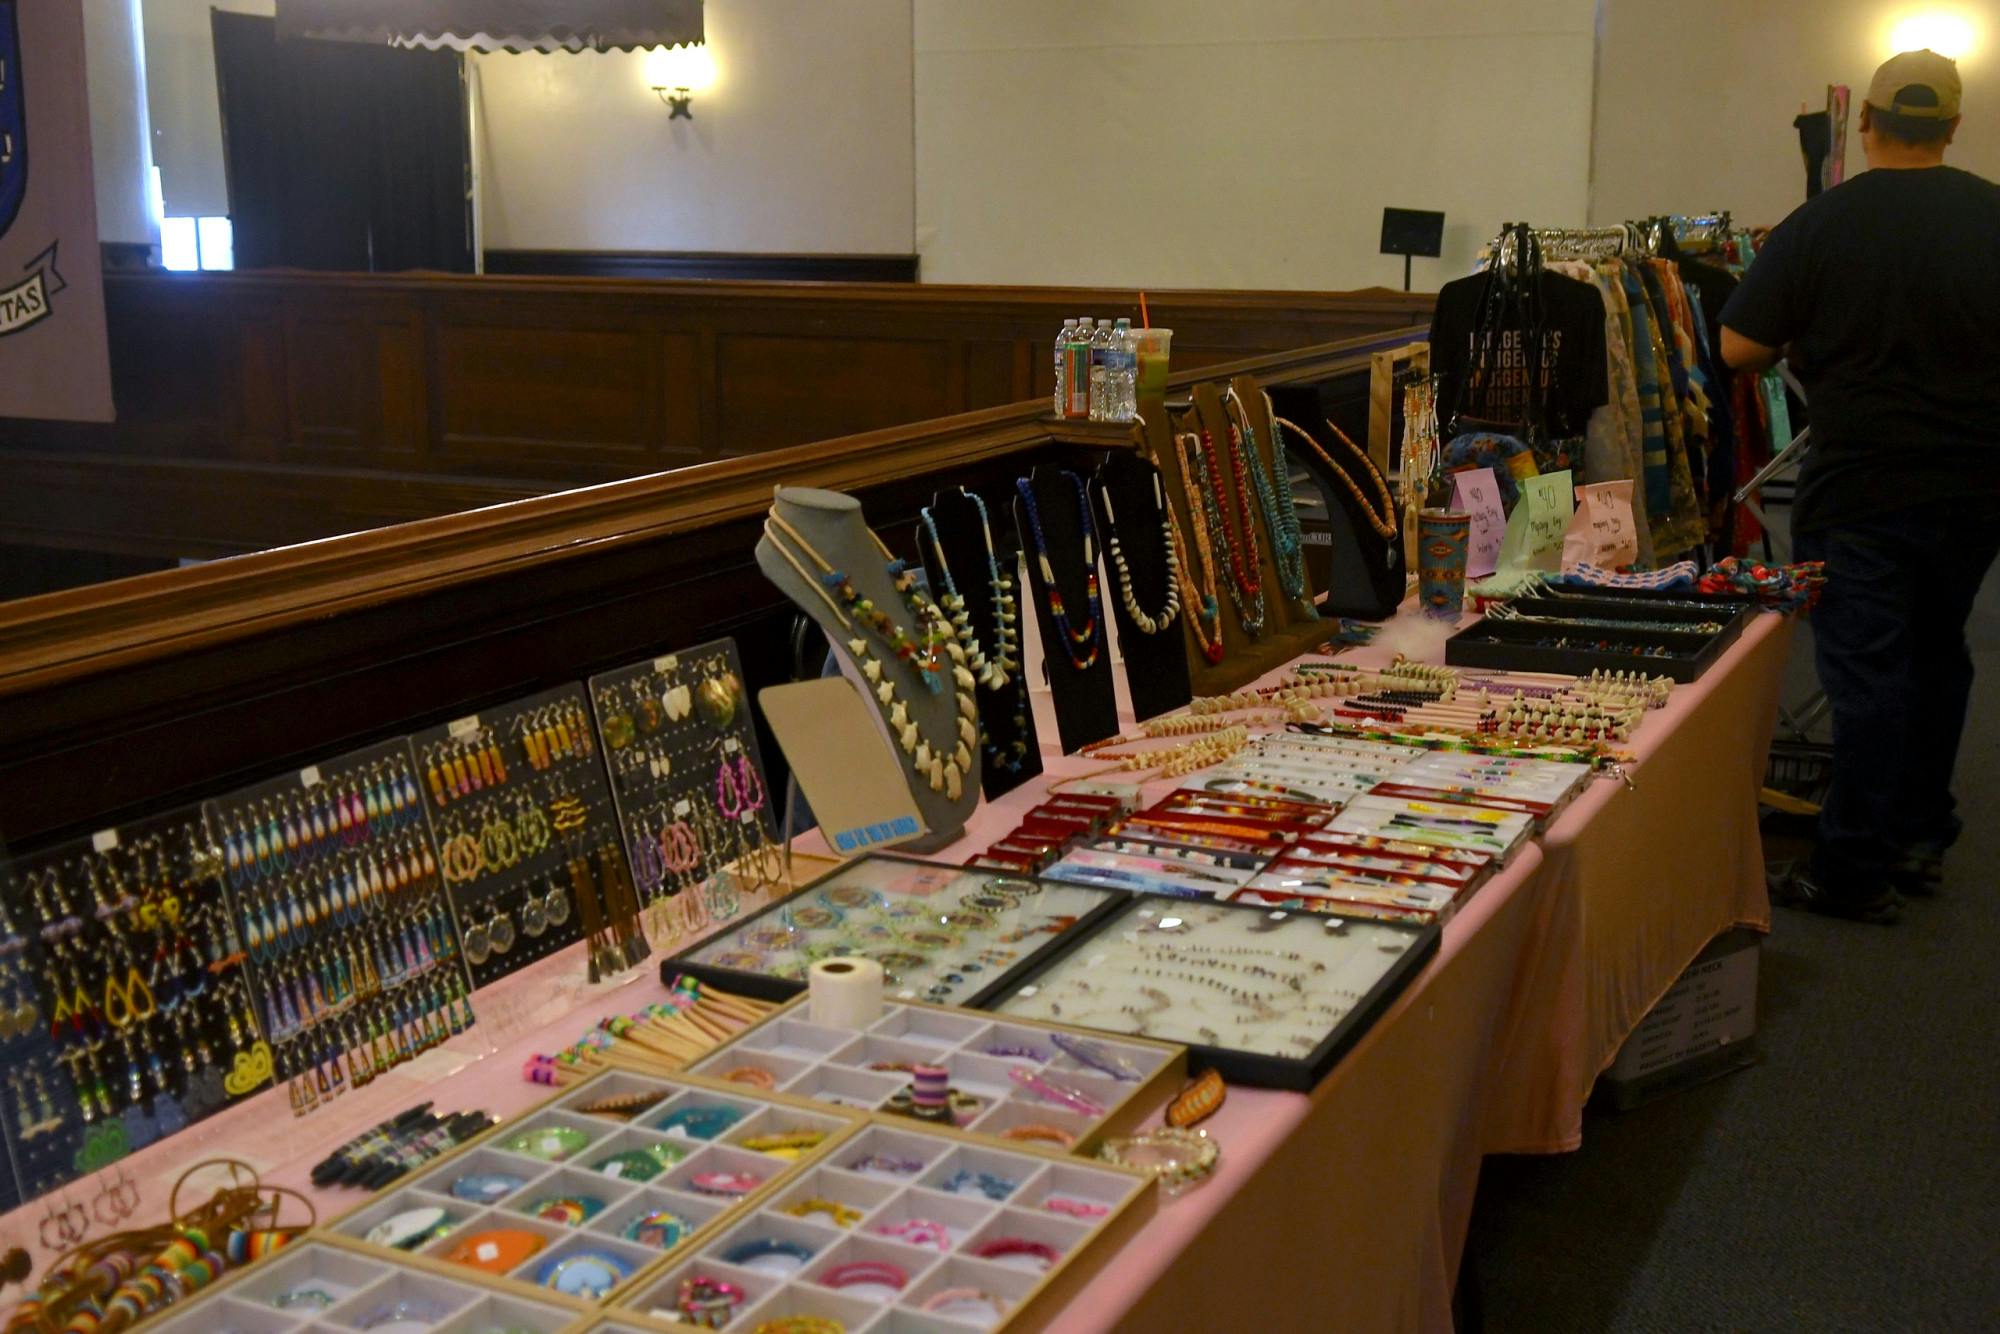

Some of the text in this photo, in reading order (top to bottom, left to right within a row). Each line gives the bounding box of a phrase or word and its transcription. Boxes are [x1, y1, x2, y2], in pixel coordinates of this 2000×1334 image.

[0, 285, 41, 325] TAS
[1469, 330, 1562, 350] IGEUS
[1469, 349, 1559, 368] IIGEUS
[1469, 368, 1558, 388] IDIGENU
